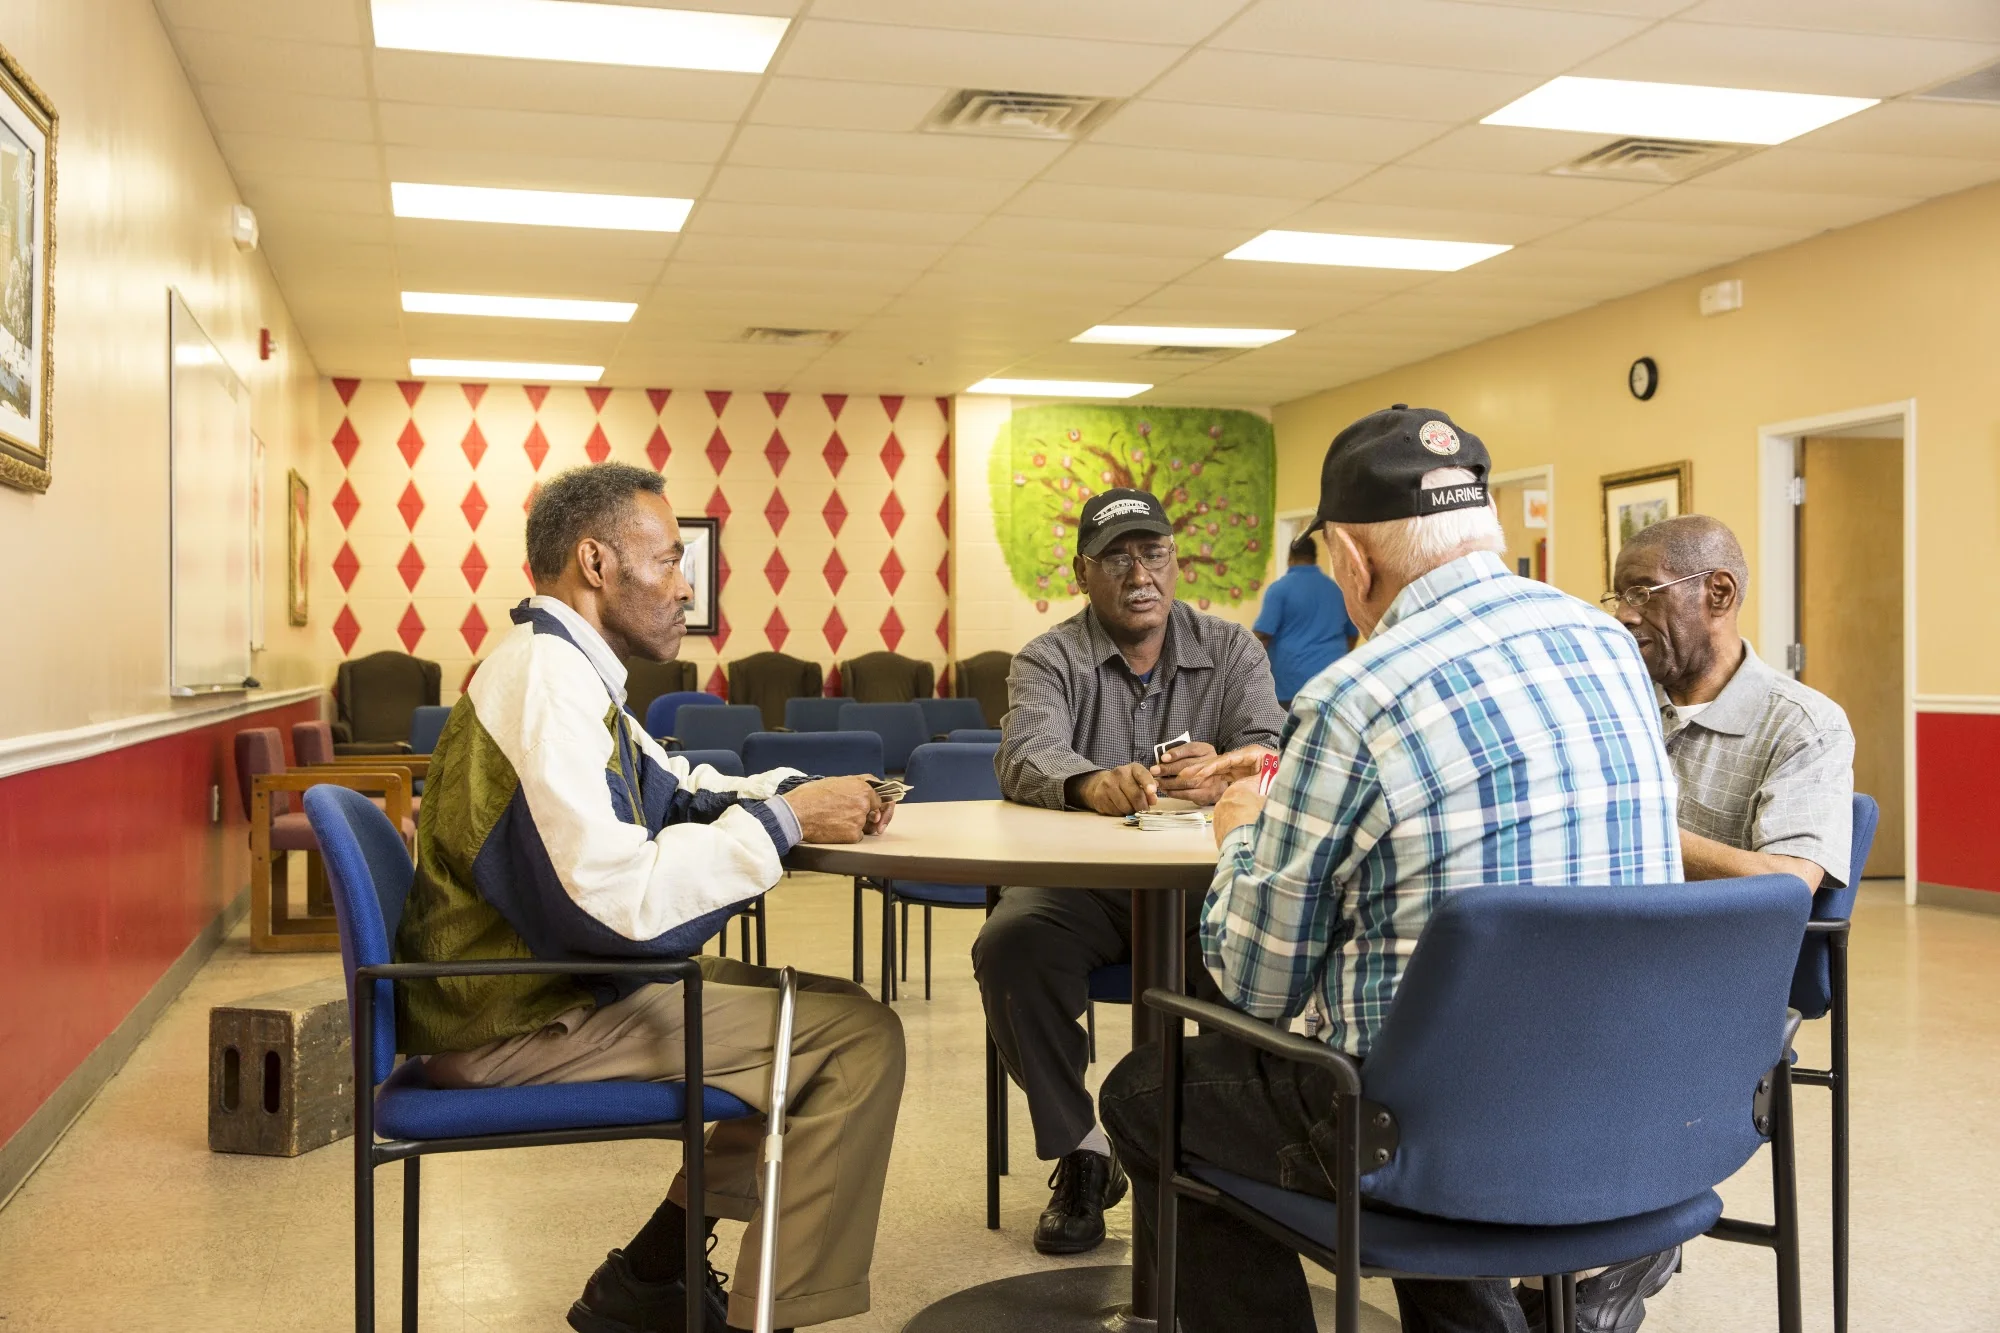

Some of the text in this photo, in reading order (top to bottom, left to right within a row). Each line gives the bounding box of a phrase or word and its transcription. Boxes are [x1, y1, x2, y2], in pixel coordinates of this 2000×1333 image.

[1431, 486, 1484, 506] MARINE
[1264, 758, 1269, 766] 5
[1273, 760, 1278, 768] 6
